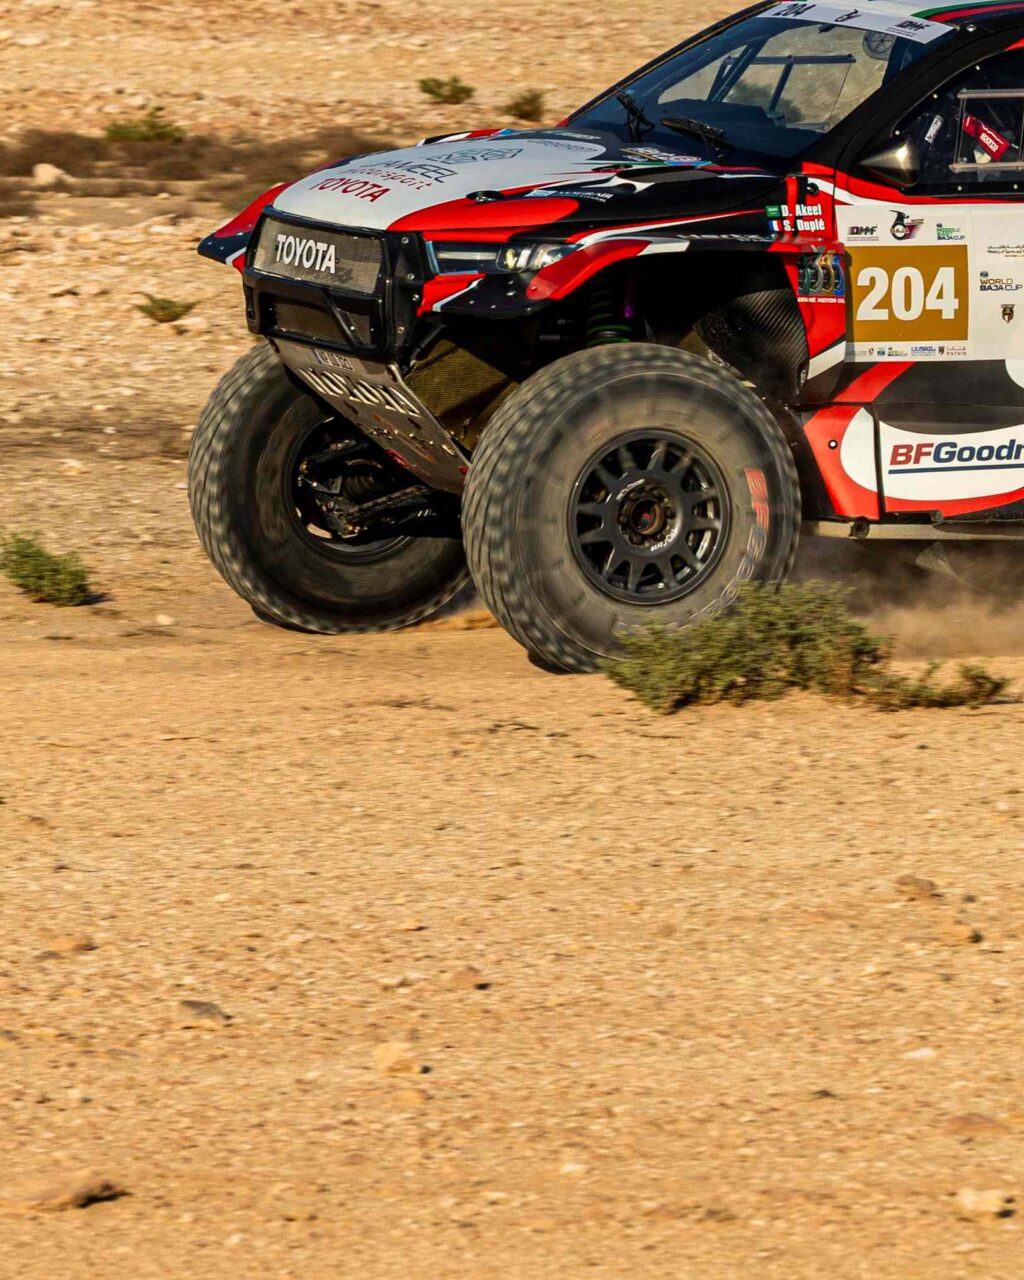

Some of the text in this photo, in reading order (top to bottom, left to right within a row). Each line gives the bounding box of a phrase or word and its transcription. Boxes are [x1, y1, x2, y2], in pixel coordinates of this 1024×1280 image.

[772, 3, 817, 17] 204
[309, 177, 391, 203] TOYOTA
[781, 203, 822, 217] D. Akeel
[783, 219, 795, 231] S.
[275, 233, 336, 274] TOYOTA
[856, 266, 960, 321] 204
